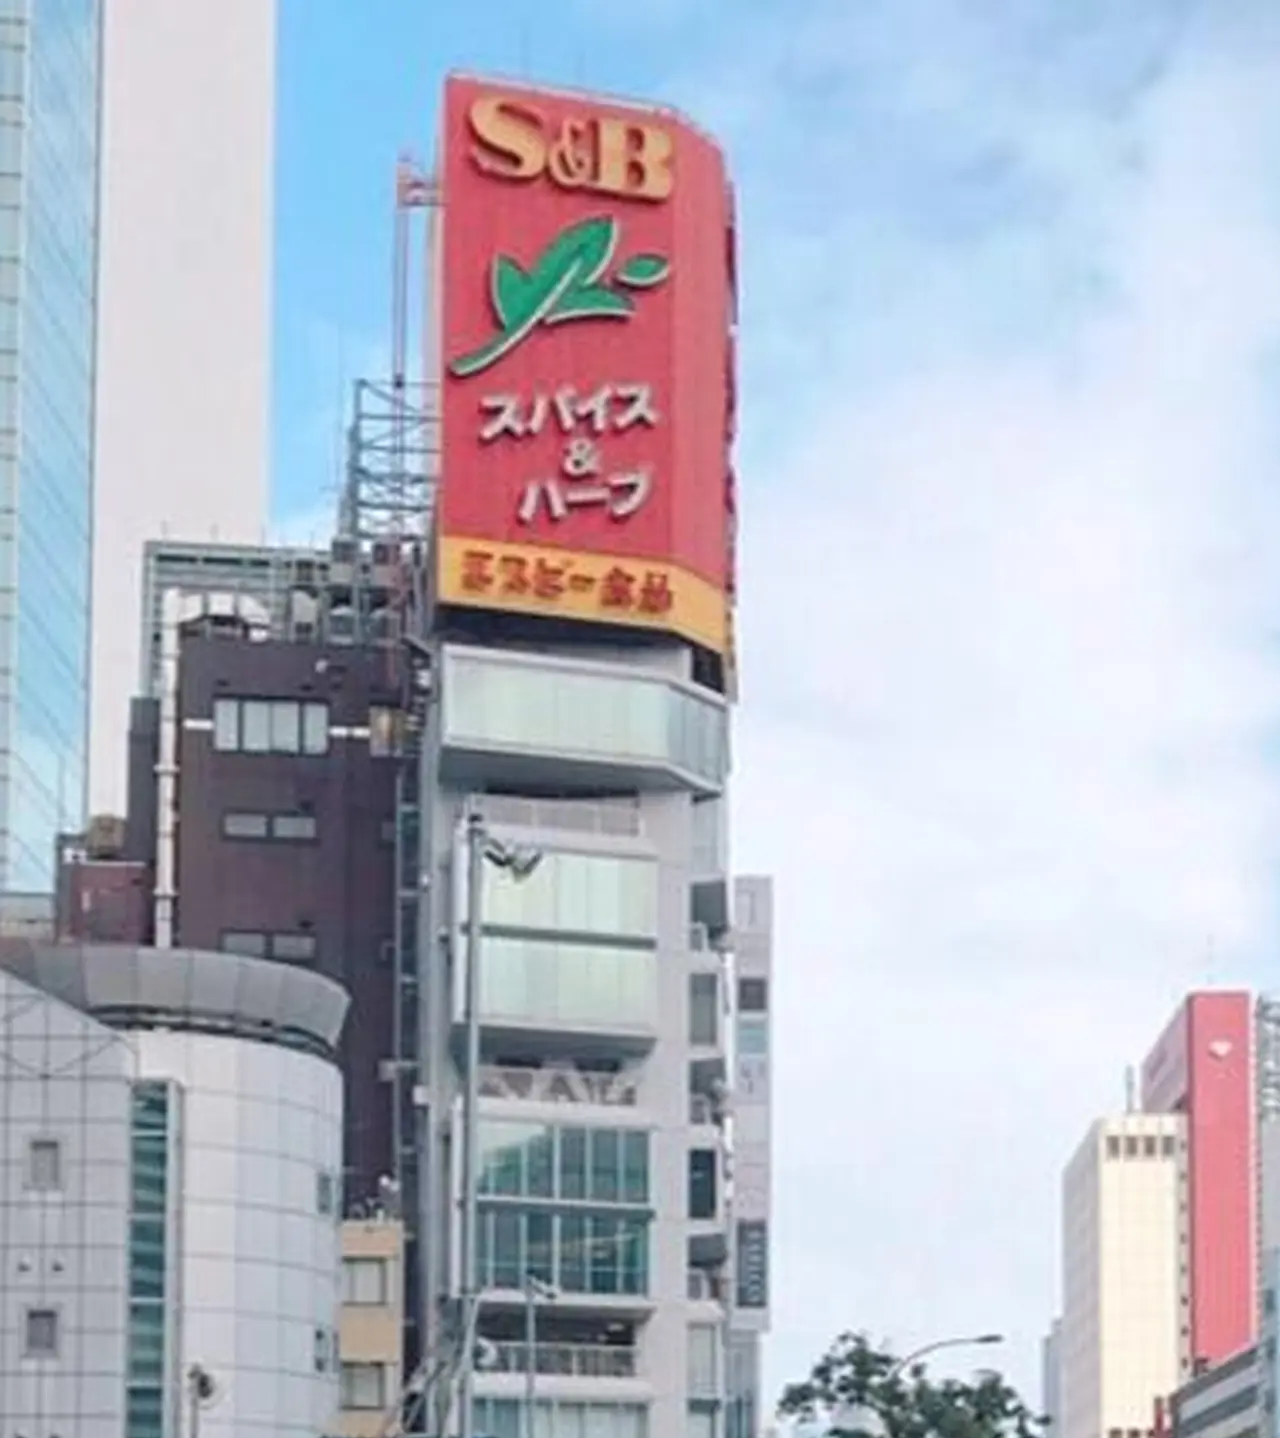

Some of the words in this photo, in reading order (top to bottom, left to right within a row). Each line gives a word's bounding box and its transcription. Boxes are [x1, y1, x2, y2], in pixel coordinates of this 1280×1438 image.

[469, 97, 672, 202] S&B
[478, 382, 662, 441] スパイス
[562, 437, 602, 478] &
